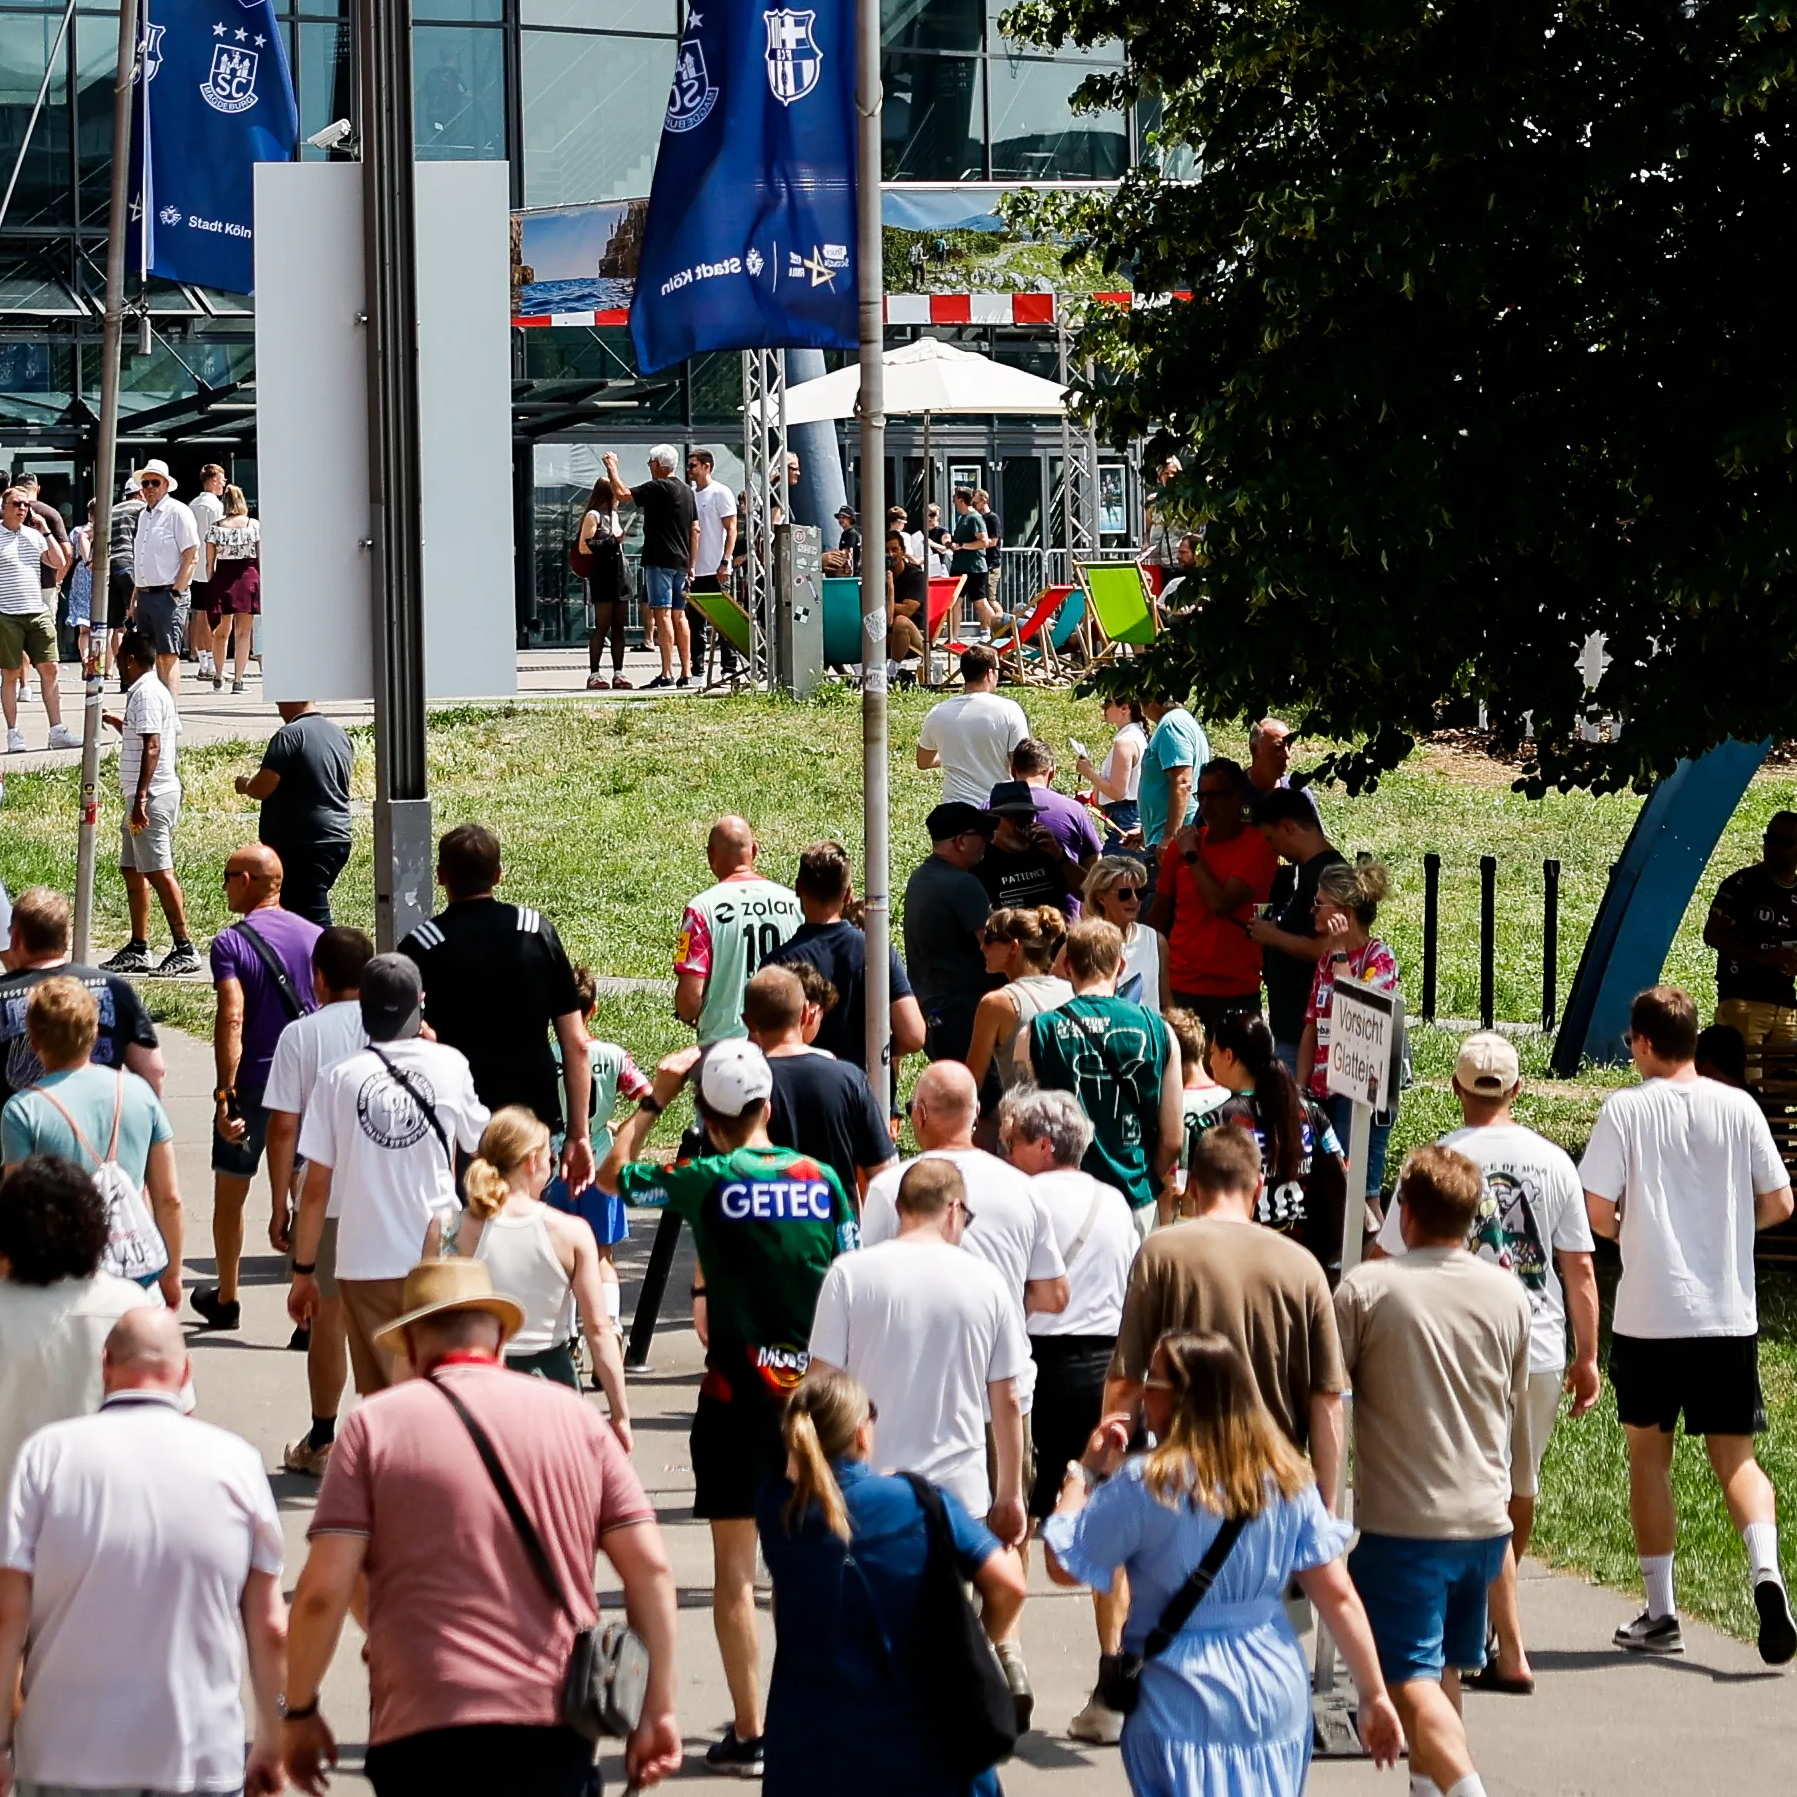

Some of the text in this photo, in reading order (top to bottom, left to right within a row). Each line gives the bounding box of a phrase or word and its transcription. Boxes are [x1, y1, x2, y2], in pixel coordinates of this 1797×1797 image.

[203, 86, 256, 111] MAGDEBURG
[215, 74, 247, 98] SC
[188, 215, 252, 240] Stadt Köln
[1001, 868, 1047, 886] PATIENCE
[743, 898, 795, 917] zolar
[1339, 1002, 1385, 1046] Vorsicht
[721, 1182, 831, 1220] GETEC
